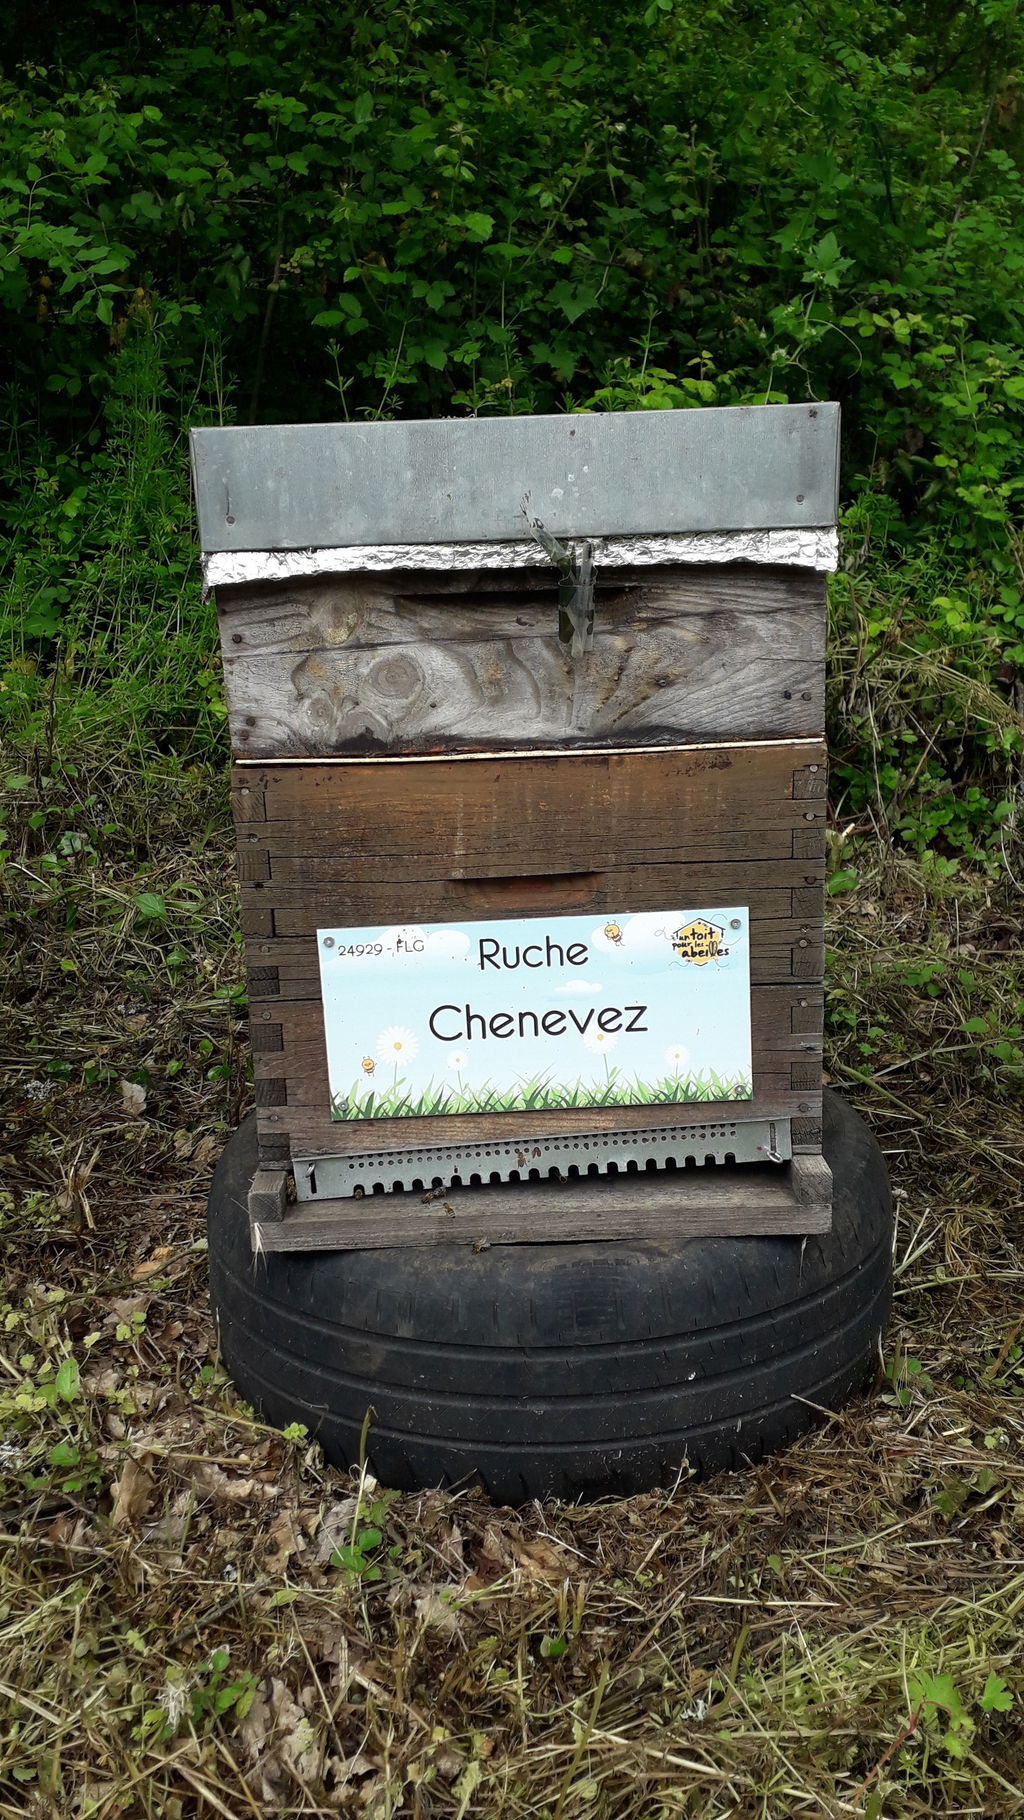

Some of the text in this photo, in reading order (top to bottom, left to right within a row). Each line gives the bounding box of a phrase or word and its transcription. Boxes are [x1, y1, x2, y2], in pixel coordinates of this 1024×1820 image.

[690, 926, 715, 940] toit
[338, 943, 383, 957] 24929
[396, 939, 425, 952] FLG
[478, 936, 589, 970] Ruche
[672, 940, 704, 951] pour les
[681, 941, 729, 957] abeilles
[428, 1003, 649, 1042] Chenevez
